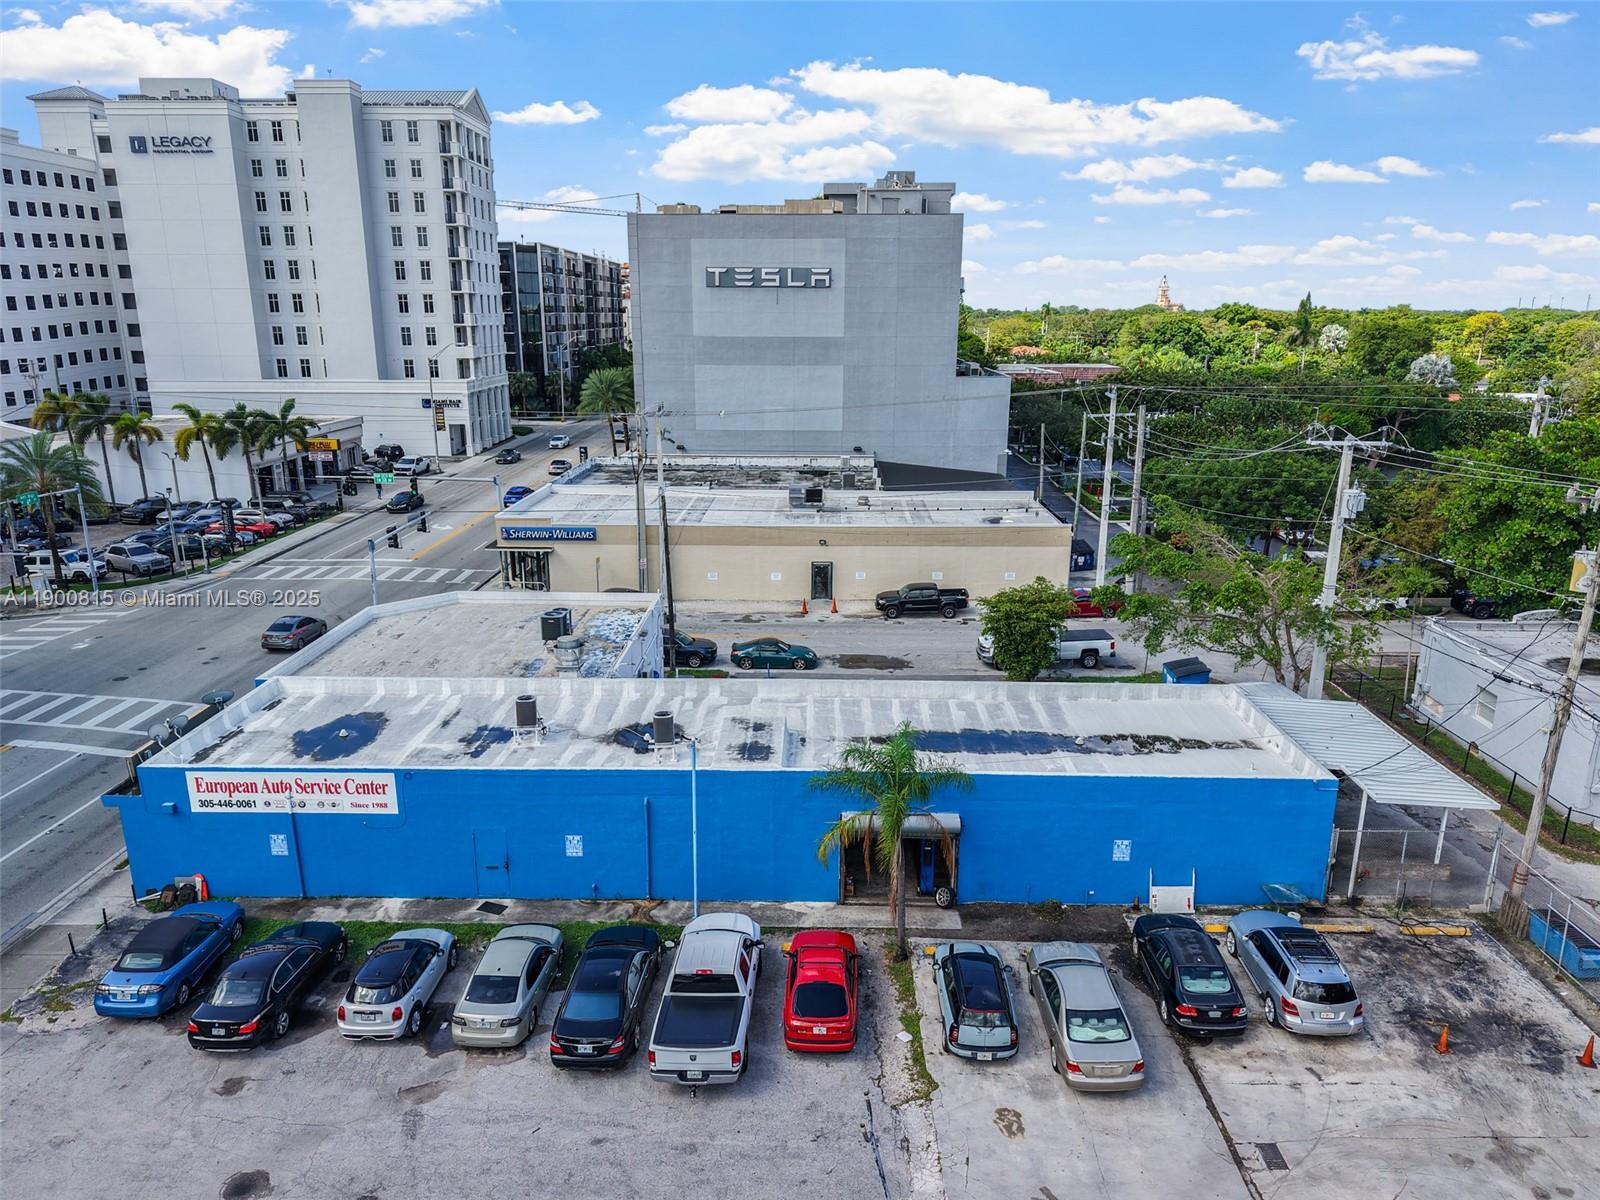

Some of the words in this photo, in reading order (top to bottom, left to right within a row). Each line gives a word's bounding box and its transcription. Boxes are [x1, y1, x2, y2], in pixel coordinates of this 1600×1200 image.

[151, 136, 212, 148] LEGACY
[706, 267, 830, 287] TESLA
[194, 777, 258, 798] European
[261, 778, 292, 794] Auto
[294, 777, 341, 795] Service
[344, 778, 389, 796] Center
[198, 799, 257, 808] 305-446-0061
[350, 801, 369, 809] Since
